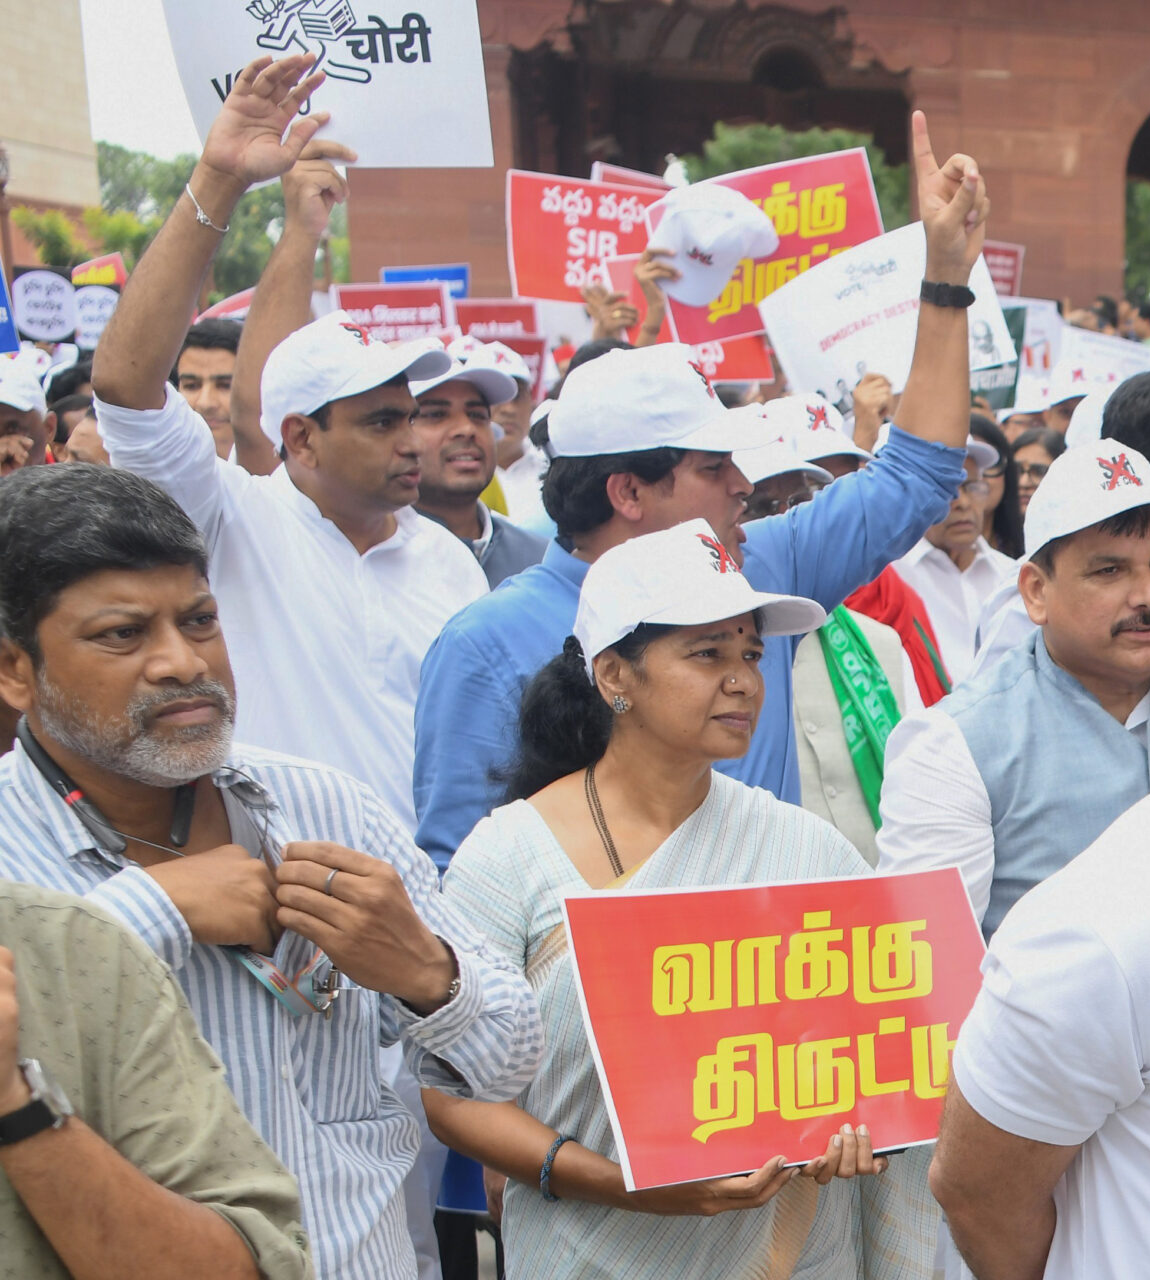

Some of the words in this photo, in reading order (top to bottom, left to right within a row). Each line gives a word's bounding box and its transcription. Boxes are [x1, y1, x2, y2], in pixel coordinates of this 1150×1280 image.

[343, 12, 432, 64] चोरी
[541, 185, 592, 226] వద్దు
[597, 193, 647, 233] వద్దు
[749, 180, 848, 239] க்கு
[567, 226, 618, 258] SIR
[564, 258, 607, 288] వద
[706, 242, 852, 324] திரு
[882, 299, 921, 320] DESTR
[651, 909, 934, 1017] வாக்கு
